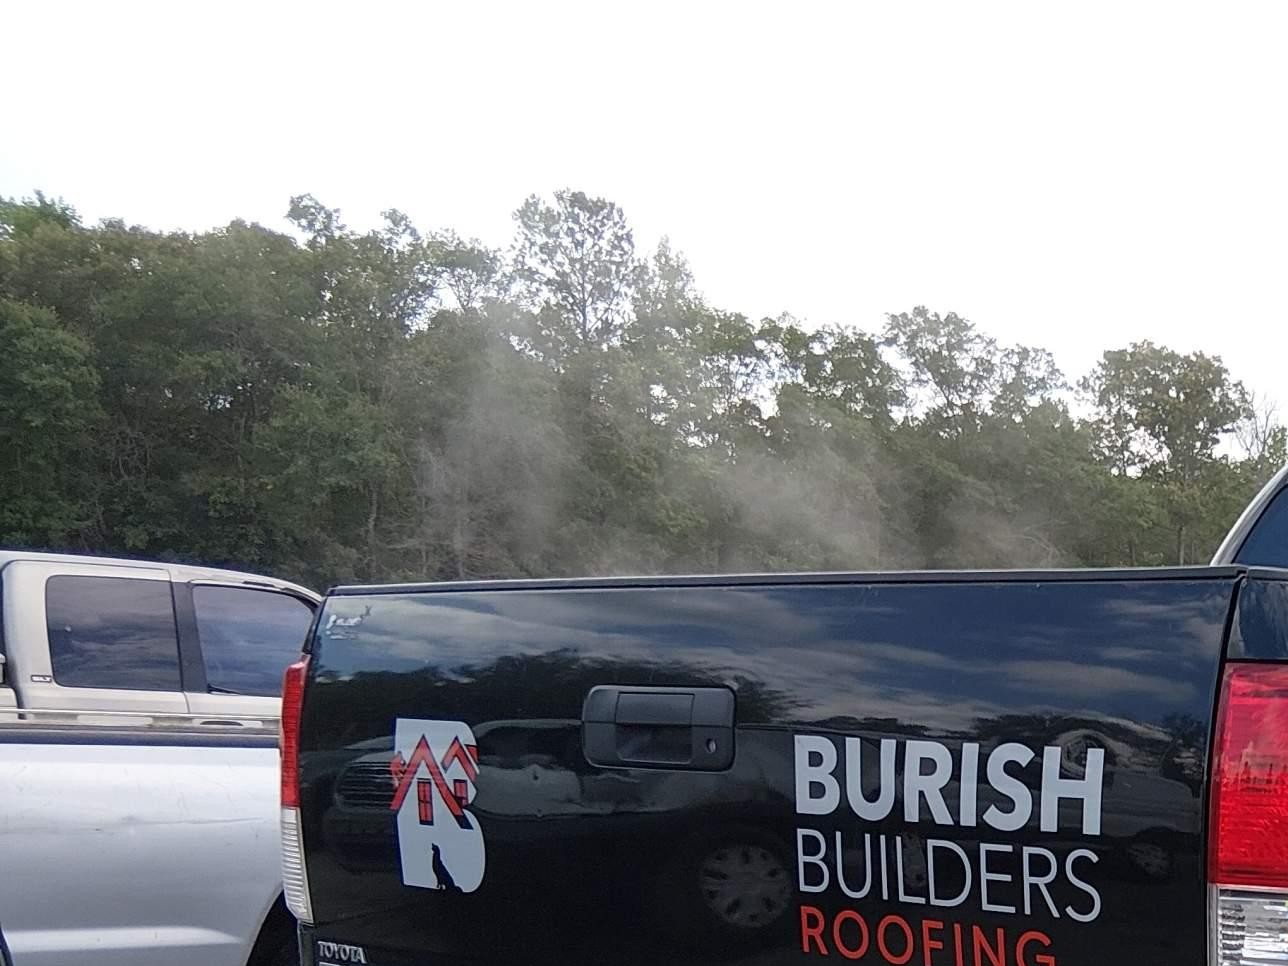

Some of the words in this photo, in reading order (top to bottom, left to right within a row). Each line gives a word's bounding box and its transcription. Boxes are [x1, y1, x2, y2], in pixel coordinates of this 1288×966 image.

[794, 734, 1105, 836] BURISH
[796, 828, 1102, 923] BUILDERS
[317, 940, 368, 964] TOYOTA
